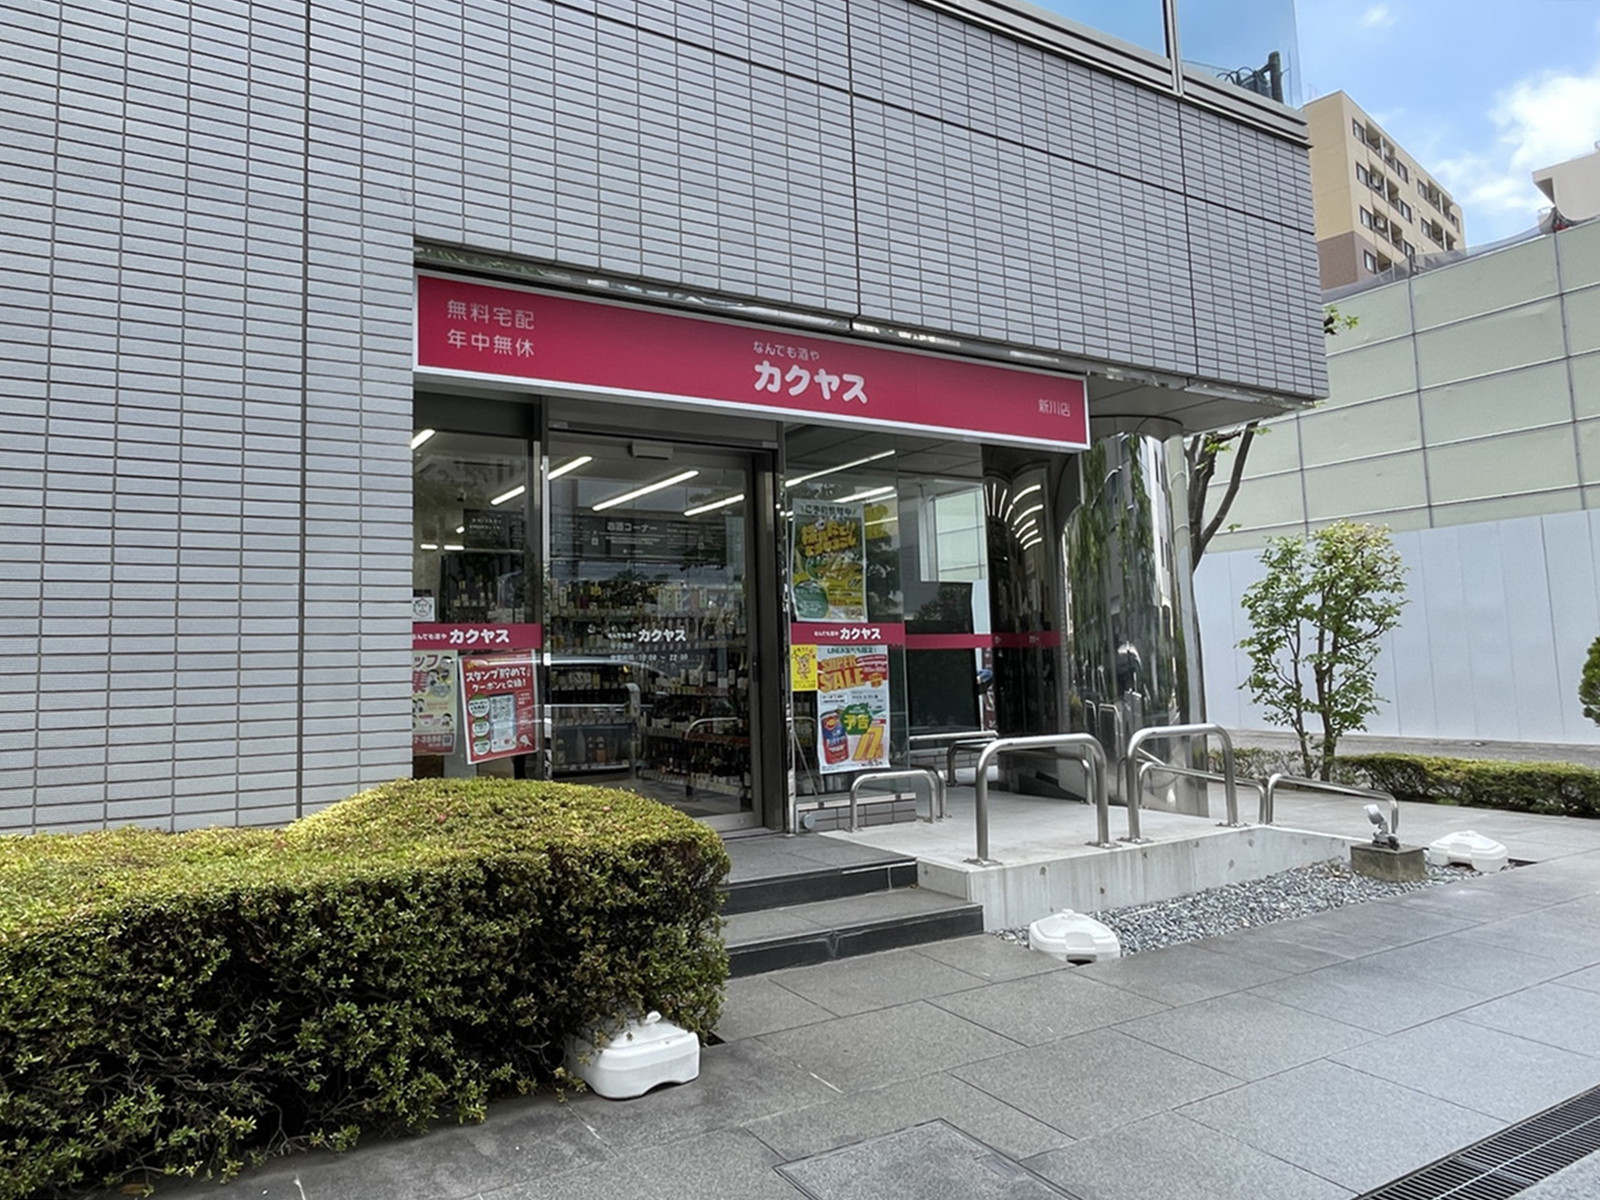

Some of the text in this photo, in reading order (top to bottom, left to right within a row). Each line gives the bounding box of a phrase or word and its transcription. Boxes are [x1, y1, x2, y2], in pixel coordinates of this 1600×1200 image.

[447, 300, 535, 330] 無料宅配
[446, 328, 535, 358] 年中無休
[753, 341, 820, 361] なんでも酒や
[754, 360, 868, 404] カクヤス
[1038, 398, 1071, 418] 新川店
[449, 628, 510, 644] カクヤス
[638, 628, 687, 643] カクヤス
[839, 627, 881, 640] カクヤス
[817, 667, 866, 694] SALE
